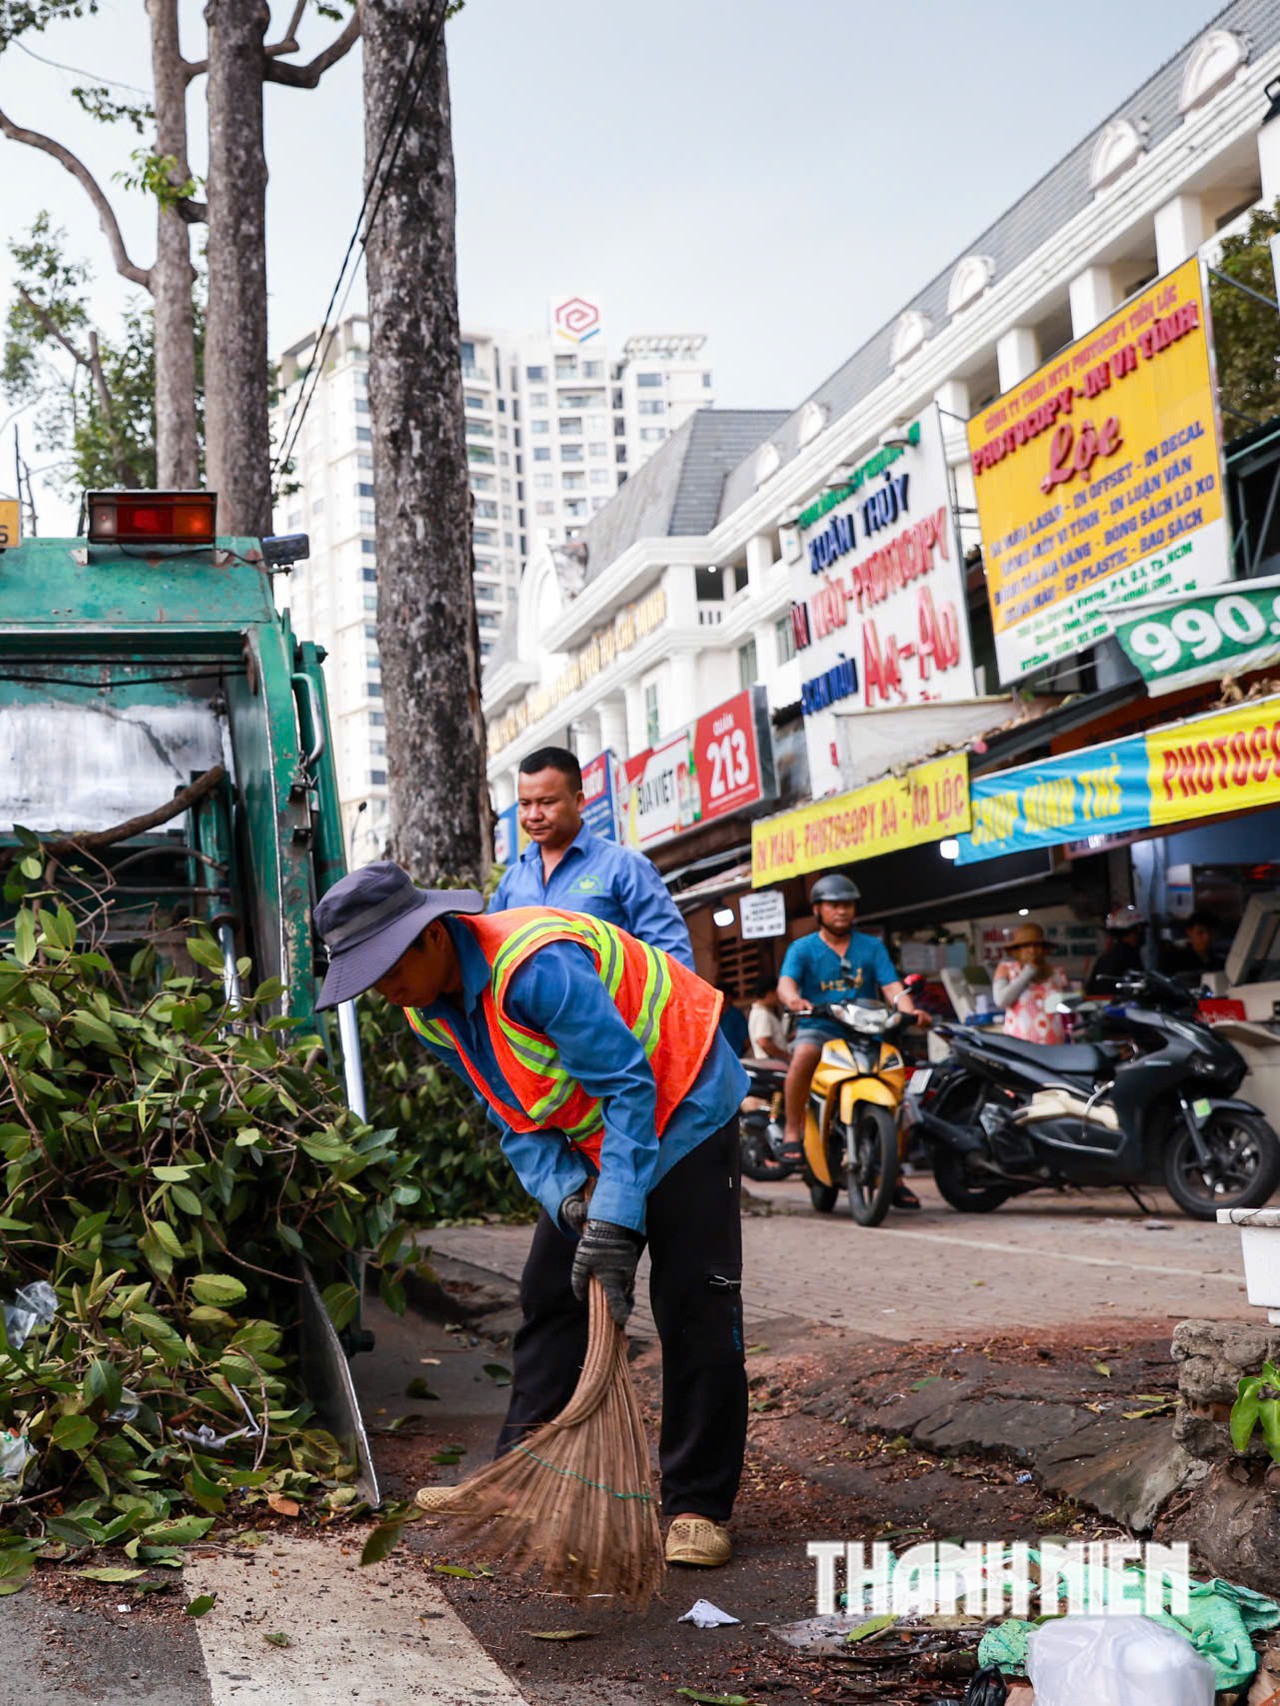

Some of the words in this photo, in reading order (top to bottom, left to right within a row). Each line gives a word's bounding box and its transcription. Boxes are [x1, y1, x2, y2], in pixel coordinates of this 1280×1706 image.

[972, 386, 1073, 477] PHOTOCOPY
[1083, 361, 1111, 400] IN
[1111, 343, 1138, 379] VI
[1040, 414, 1125, 496] Lộc
[1073, 490, 1087, 509] IN
[1089, 462, 1133, 499] OFFSET
[1144, 446, 1158, 467] IN
[1161, 420, 1205, 457] DECAL
[1195, 474, 1215, 497] XO
[1110, 496, 1124, 515] IN
[1081, 547, 1127, 584] PLASTIC
[1140, 528, 1165, 553] BAO
[1130, 594, 1280, 672] 990.
[706, 728, 750, 799] 213
[804, 802, 875, 859] PHOTOCOPY
[881, 795, 897, 838] A4
